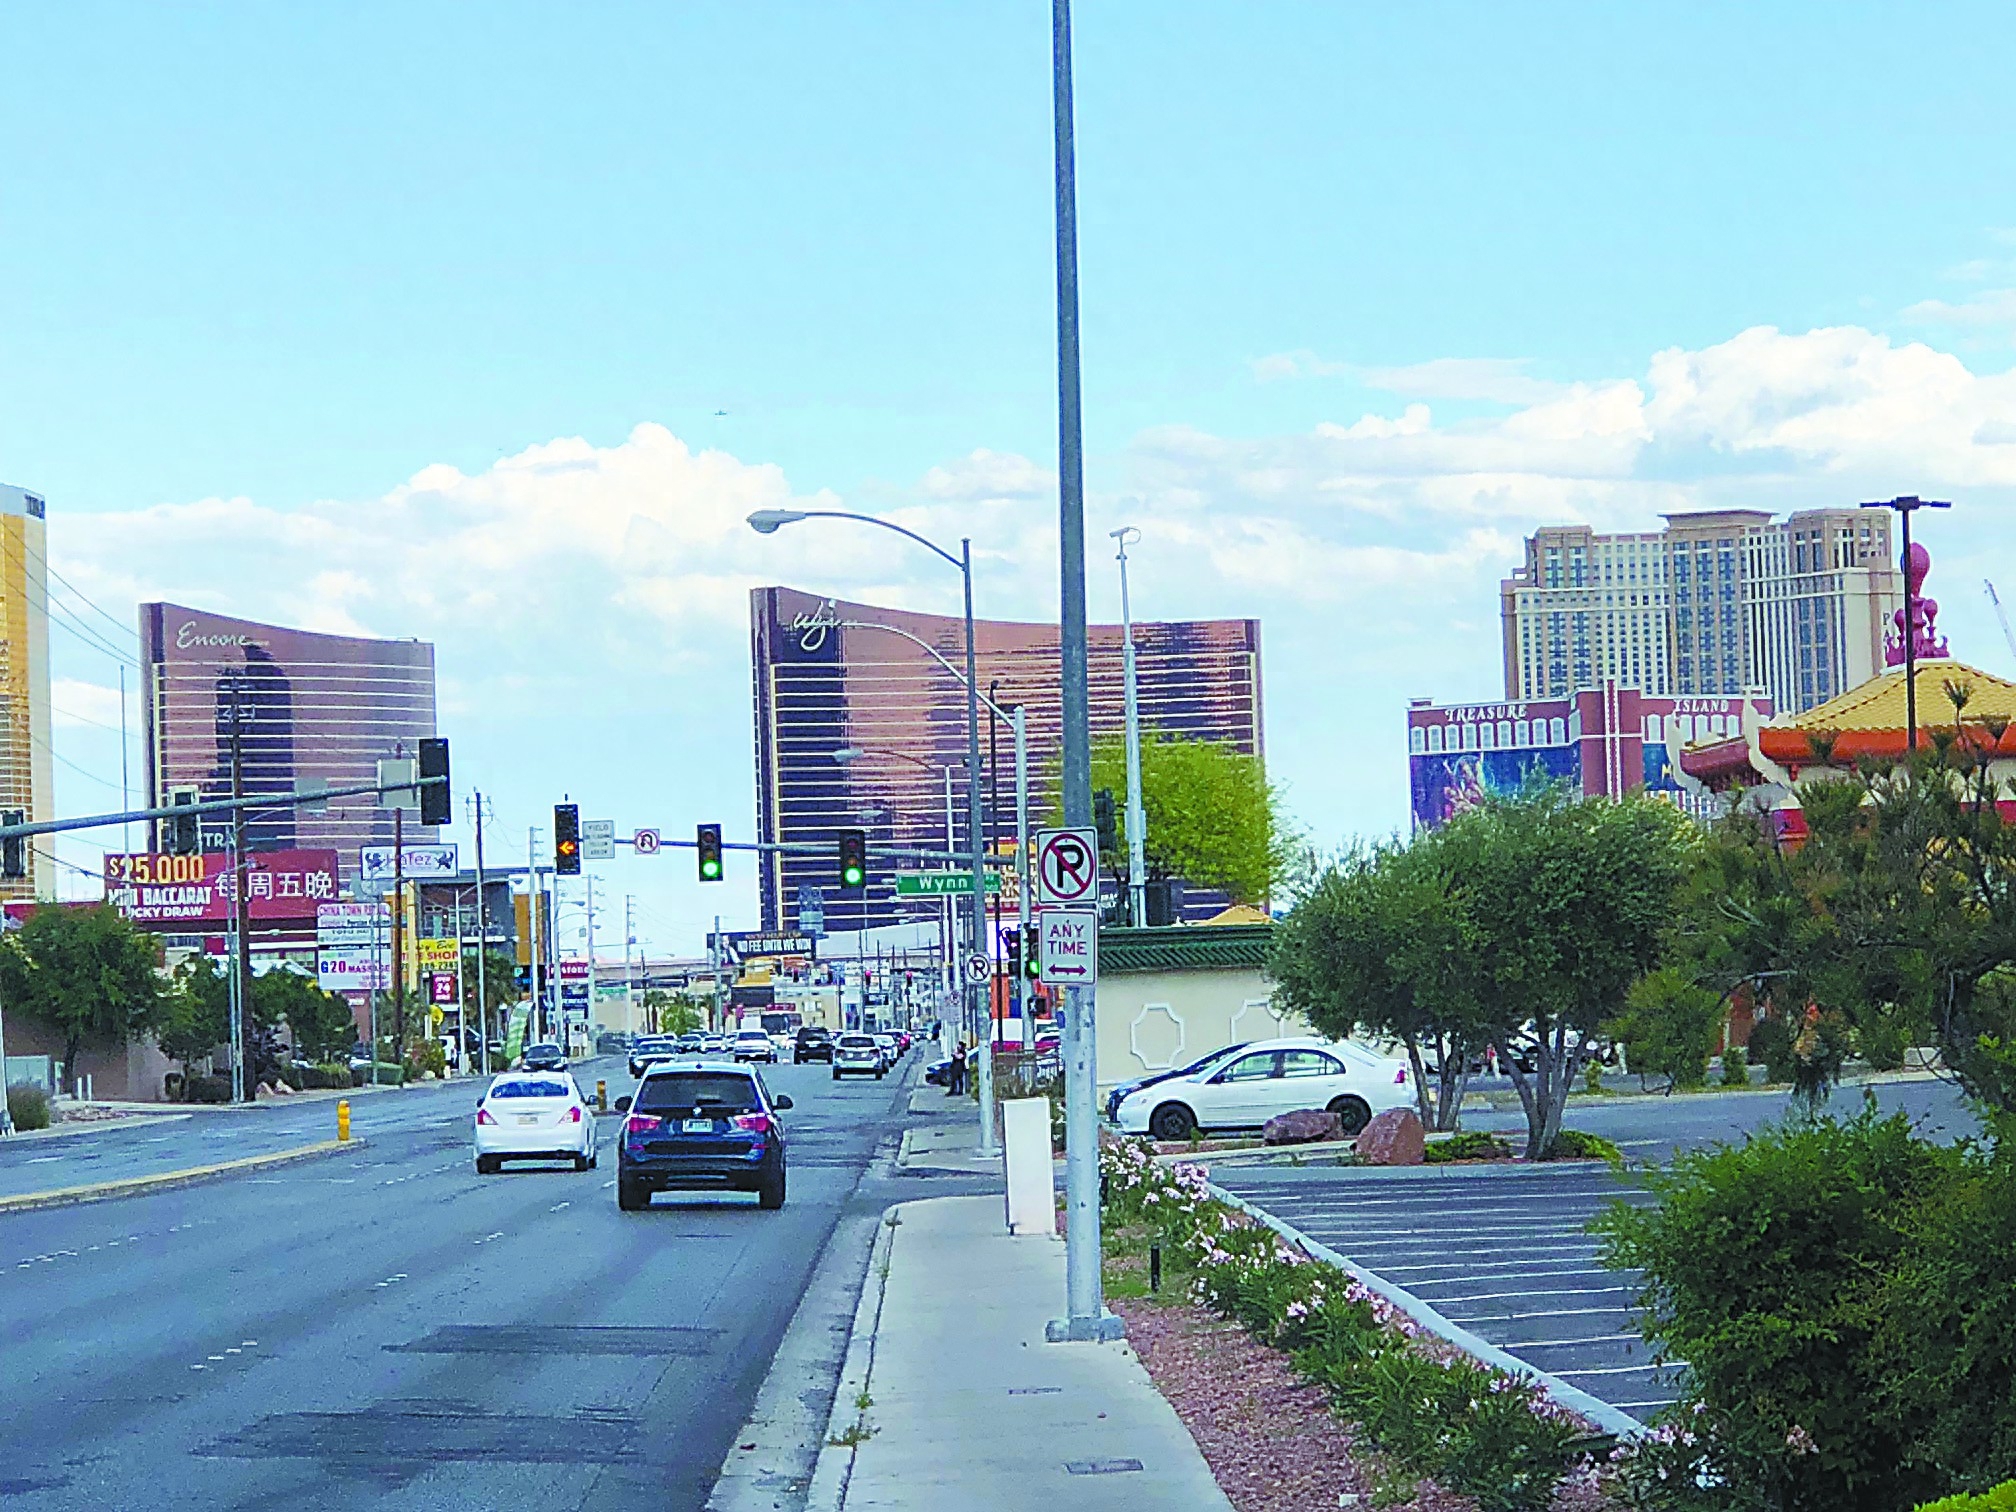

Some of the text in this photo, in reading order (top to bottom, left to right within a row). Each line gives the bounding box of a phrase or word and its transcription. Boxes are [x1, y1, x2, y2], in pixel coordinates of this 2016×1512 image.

[176, 620, 270, 649] Encore
[1445, 699, 1730, 722] TREASURE ISLAND
[919, 875, 968, 894] Wynn
[142, 886, 212, 905] BACCARAT
[163, 906, 204, 917] DRAW
[1049, 923, 1085, 938] ANY
[748, 939, 762, 952] FEE
[783, 938, 795, 951] WE
[1047, 940, 1088, 956] TIME
